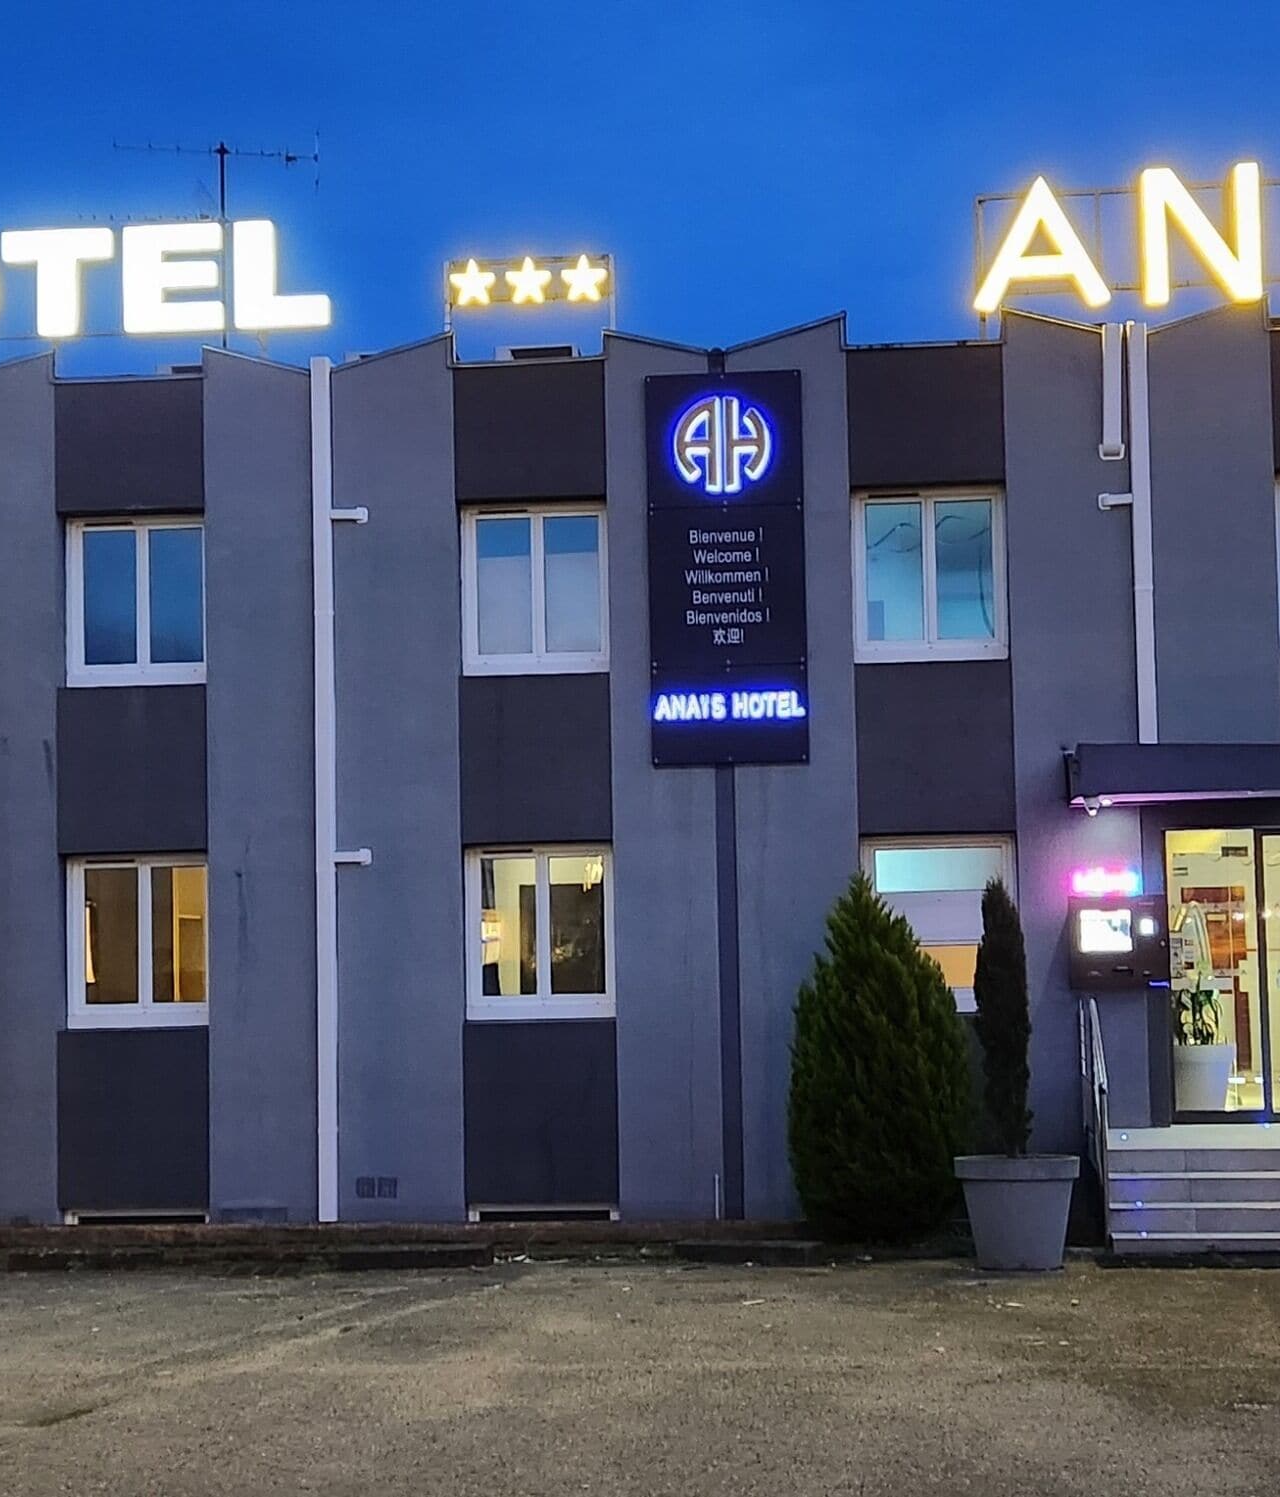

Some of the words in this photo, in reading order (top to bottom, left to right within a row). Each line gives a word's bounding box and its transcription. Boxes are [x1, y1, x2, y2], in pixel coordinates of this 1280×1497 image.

[689, 529, 756, 544] Bienvenue
[693, 548, 752, 564] Welcome
[685, 569, 761, 585] Willkommen
[692, 587, 755, 604] Benvenuti
[686, 608, 762, 625] Bienvenidos
[731, 690, 806, 719] HOTEL
